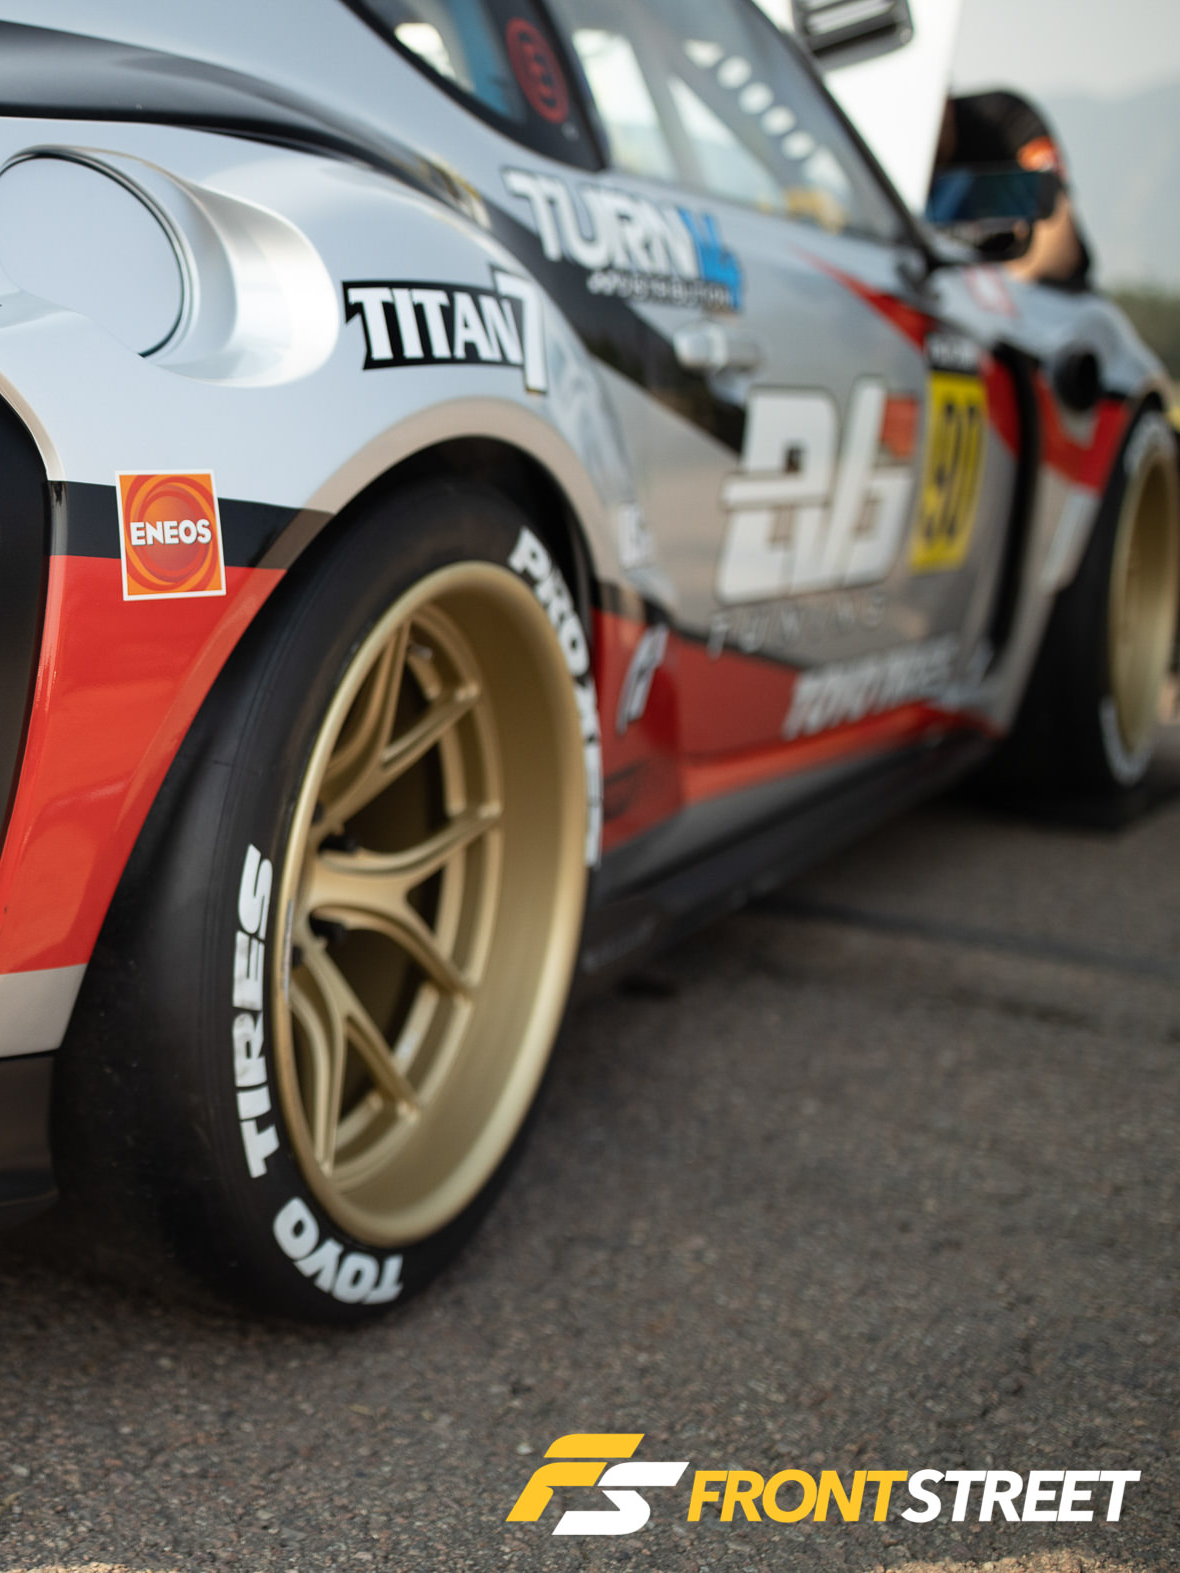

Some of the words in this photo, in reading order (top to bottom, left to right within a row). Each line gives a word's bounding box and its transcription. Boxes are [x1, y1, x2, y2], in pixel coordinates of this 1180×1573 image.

[129, 518, 212, 546] ENEOS
[231, 843, 280, 1179] TIRES
[273, 1196, 404, 1306] TOYO
